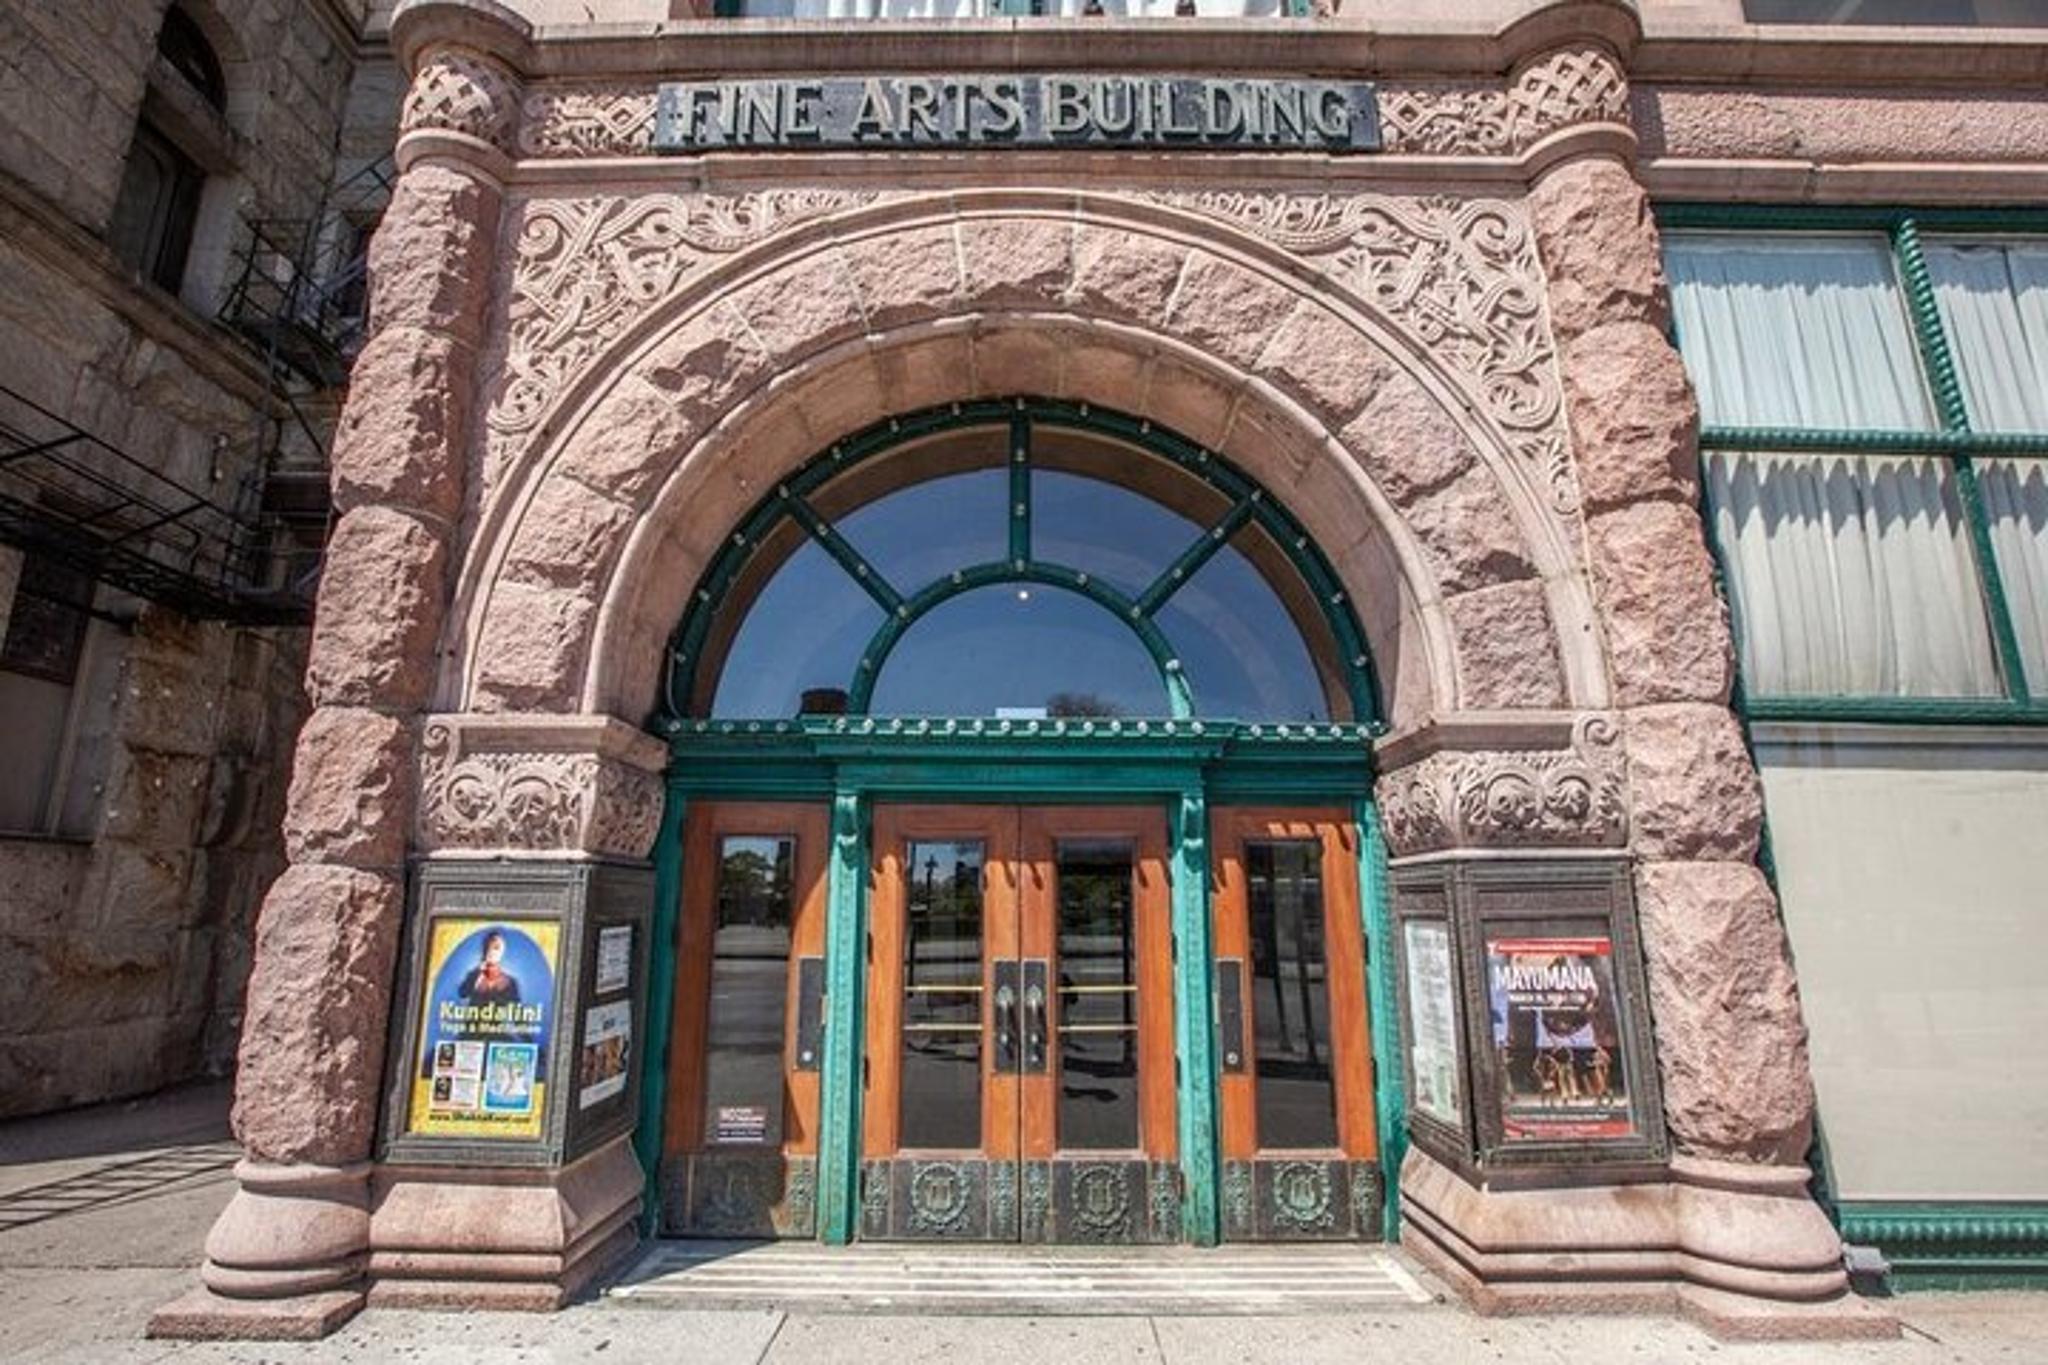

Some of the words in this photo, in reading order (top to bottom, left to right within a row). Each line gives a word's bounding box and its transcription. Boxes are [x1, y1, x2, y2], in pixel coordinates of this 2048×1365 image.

[681, 79, 824, 142] FINE
[851, 76, 1022, 141] ARTS
[1043, 75, 1351, 141] BUILDING
[440, 1001, 543, 1021] Kundalini
